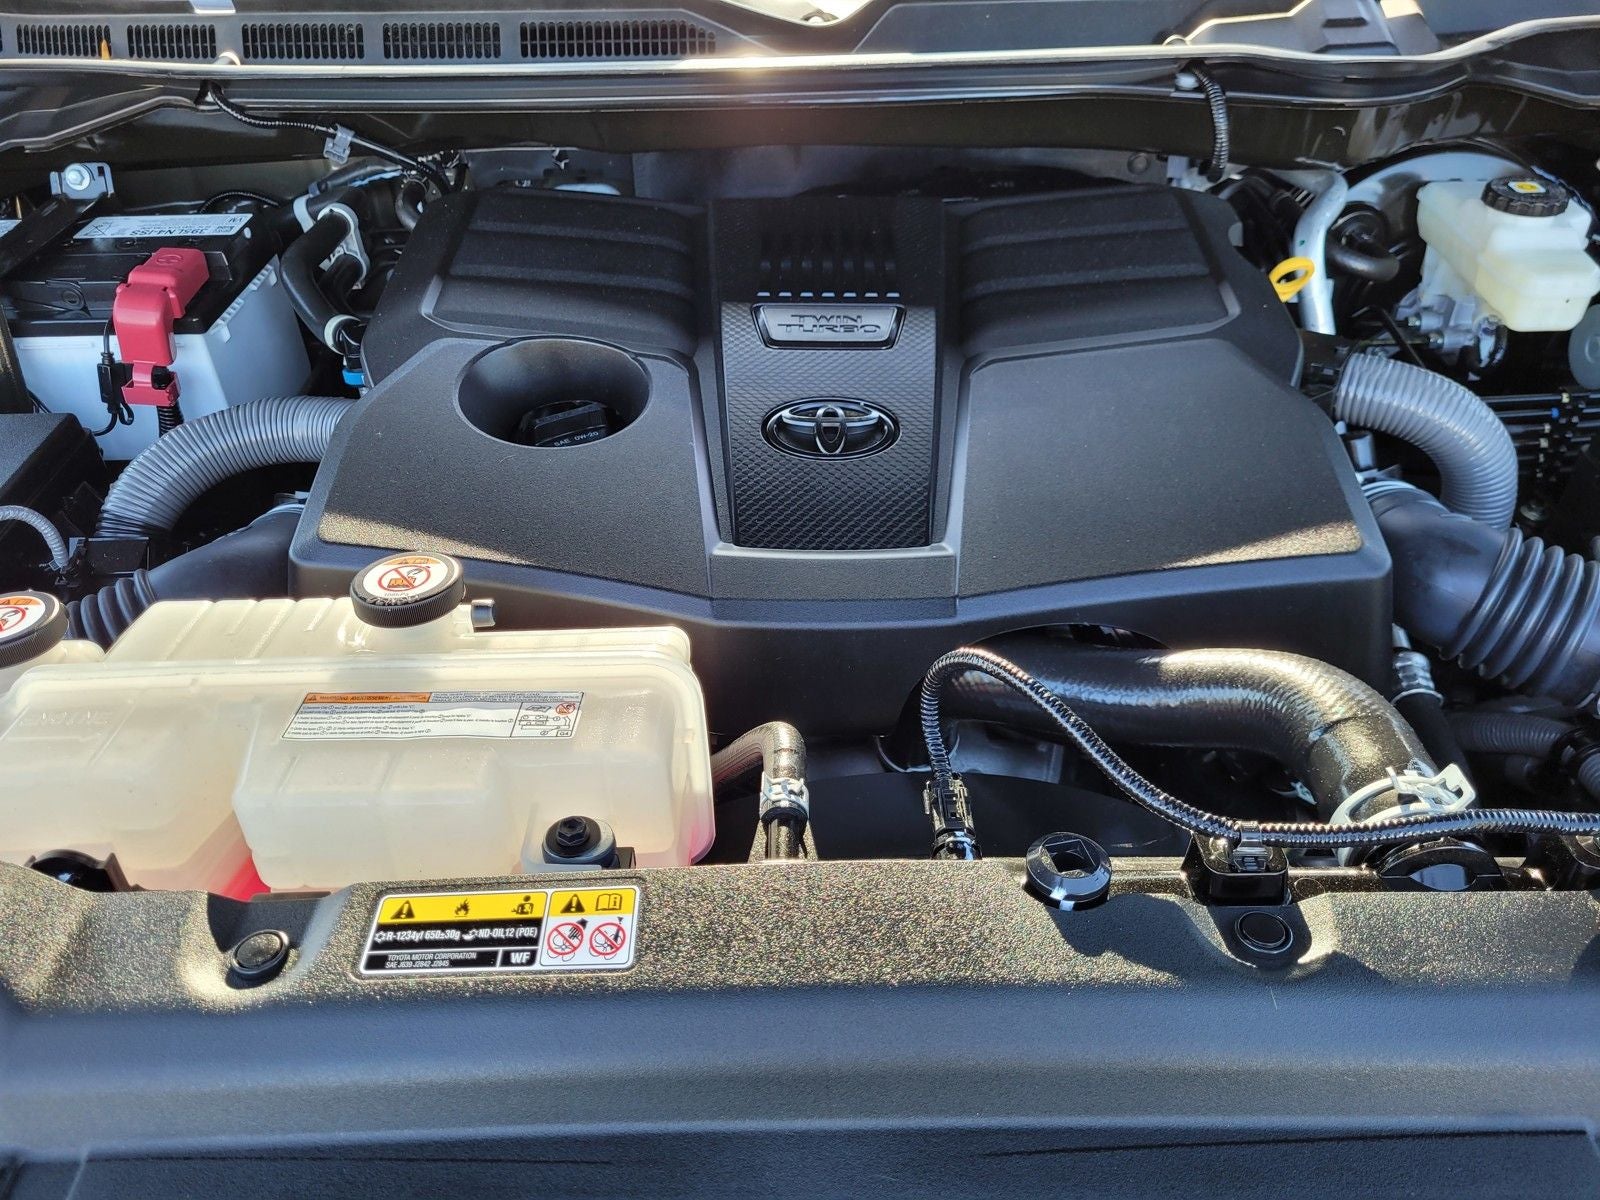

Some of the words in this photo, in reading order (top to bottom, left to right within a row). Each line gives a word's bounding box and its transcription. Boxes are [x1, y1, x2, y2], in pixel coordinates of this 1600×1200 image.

[790, 314, 863, 324] TWIN
[777, 323, 881, 333] TURBO
[553, 438, 572, 447] SAE
[574, 431, 599, 441] 0W-20
[424, 929, 461, 941] 650±30g
[515, 926, 538, 939] (POE)
[411, 953, 434, 961] MOTOR
[434, 952, 477, 960] CORPORATION
[510, 951, 531, 964] WF
